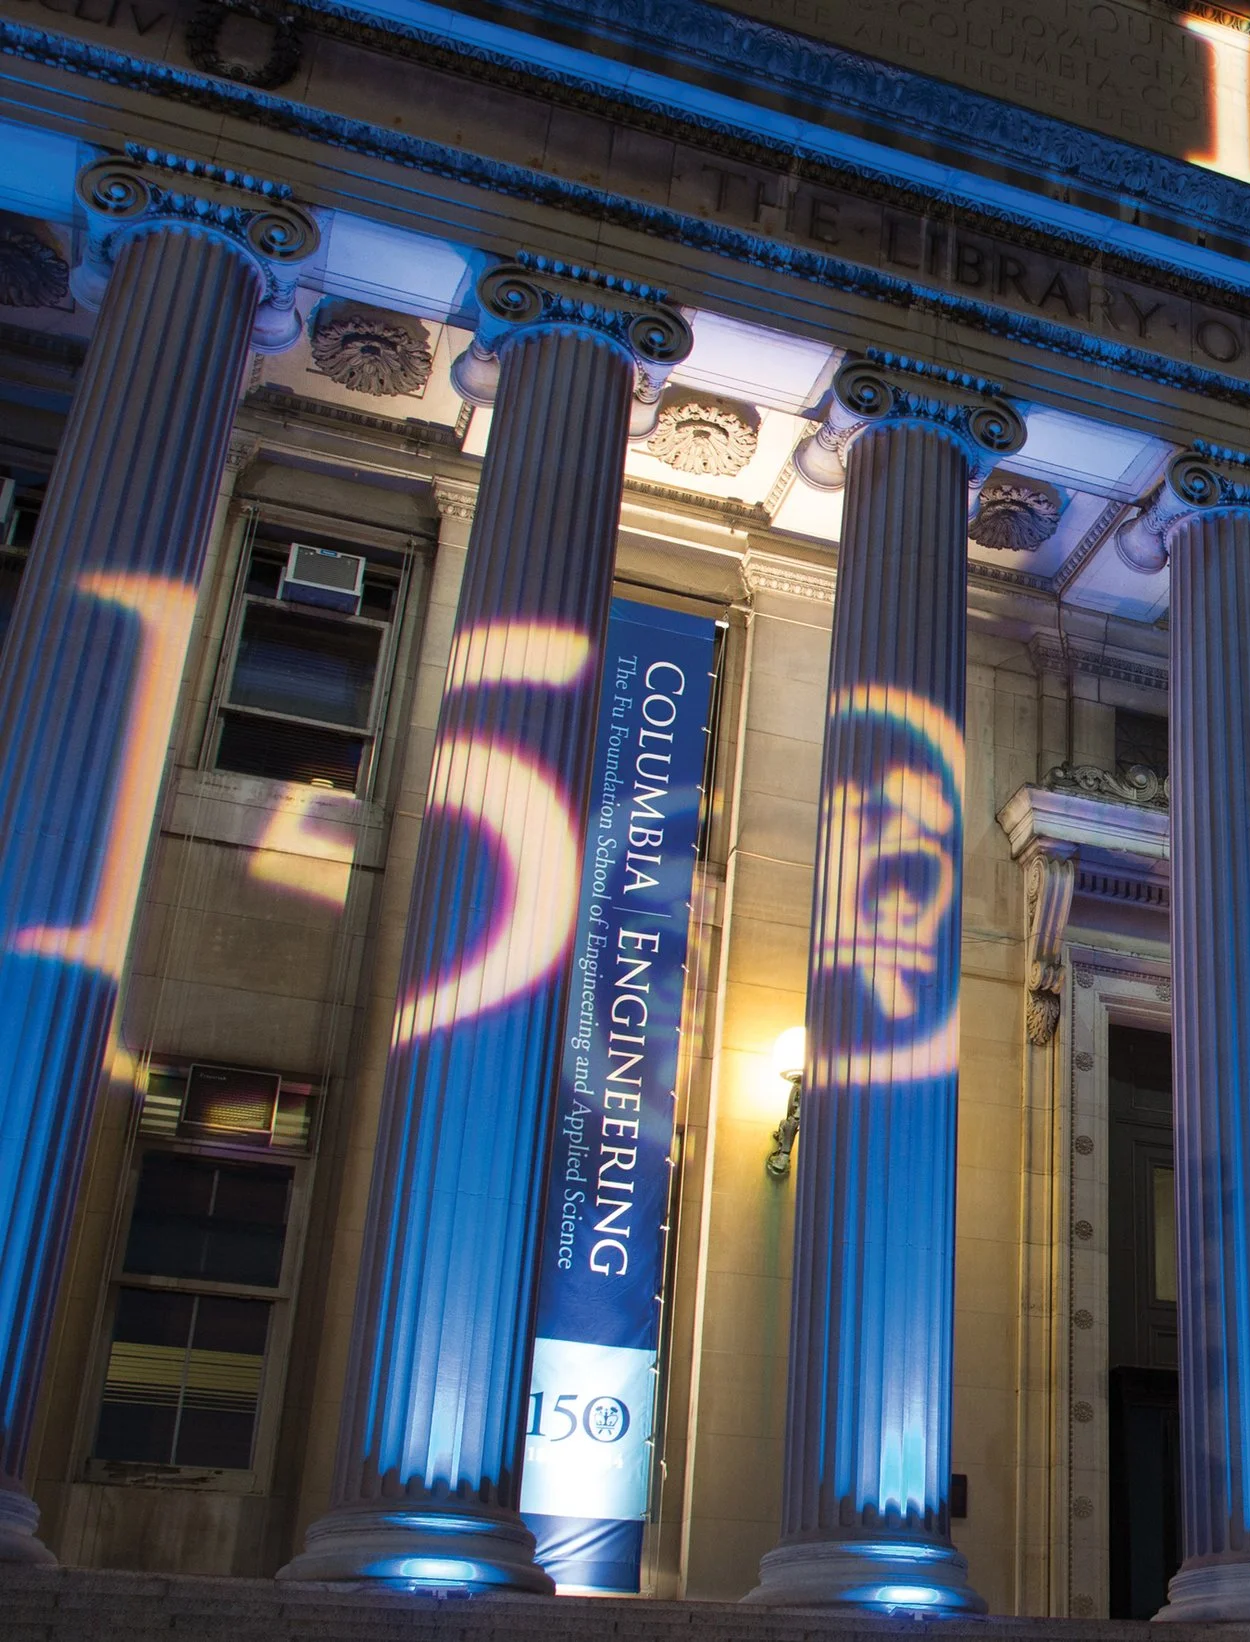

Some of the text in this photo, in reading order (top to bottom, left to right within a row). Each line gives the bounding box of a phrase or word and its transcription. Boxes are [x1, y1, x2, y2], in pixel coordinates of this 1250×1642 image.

[897, 2, 1123, 97] COLUMBIA
[701, 162, 840, 246] THE
[884, 207, 1162, 341] LIBRARY
[556, 655, 638, 1270] The Fu Foundation School of Engineering and Applied Science
[587, 660, 686, 1278] COLUMBIA ENGINEERING
[526, 1391, 631, 1443] 150
